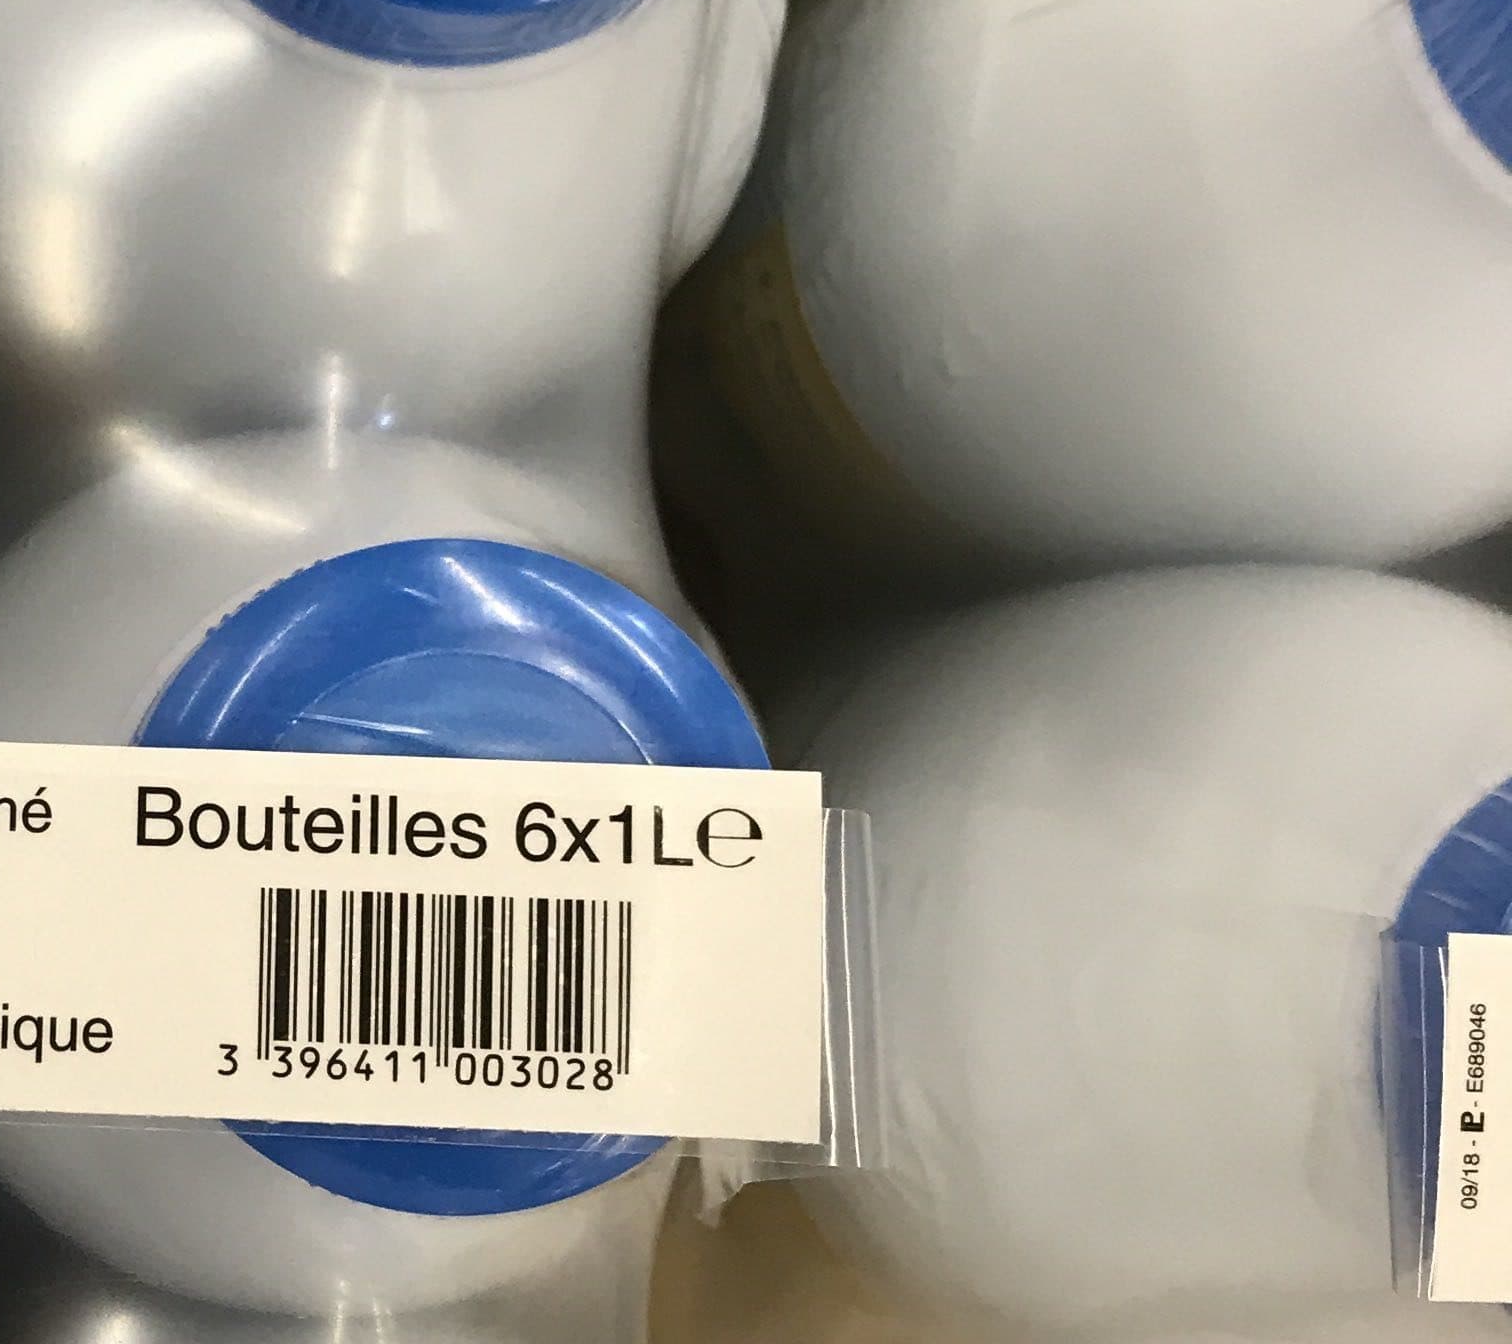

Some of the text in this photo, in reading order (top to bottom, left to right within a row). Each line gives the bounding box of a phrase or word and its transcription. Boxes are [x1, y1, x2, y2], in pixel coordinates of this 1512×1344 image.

[137, 786, 487, 859] Bouteilles
[1467, 1004, 1486, 1092] E689046
[1461, 1154, 1480, 1209] 09/18
